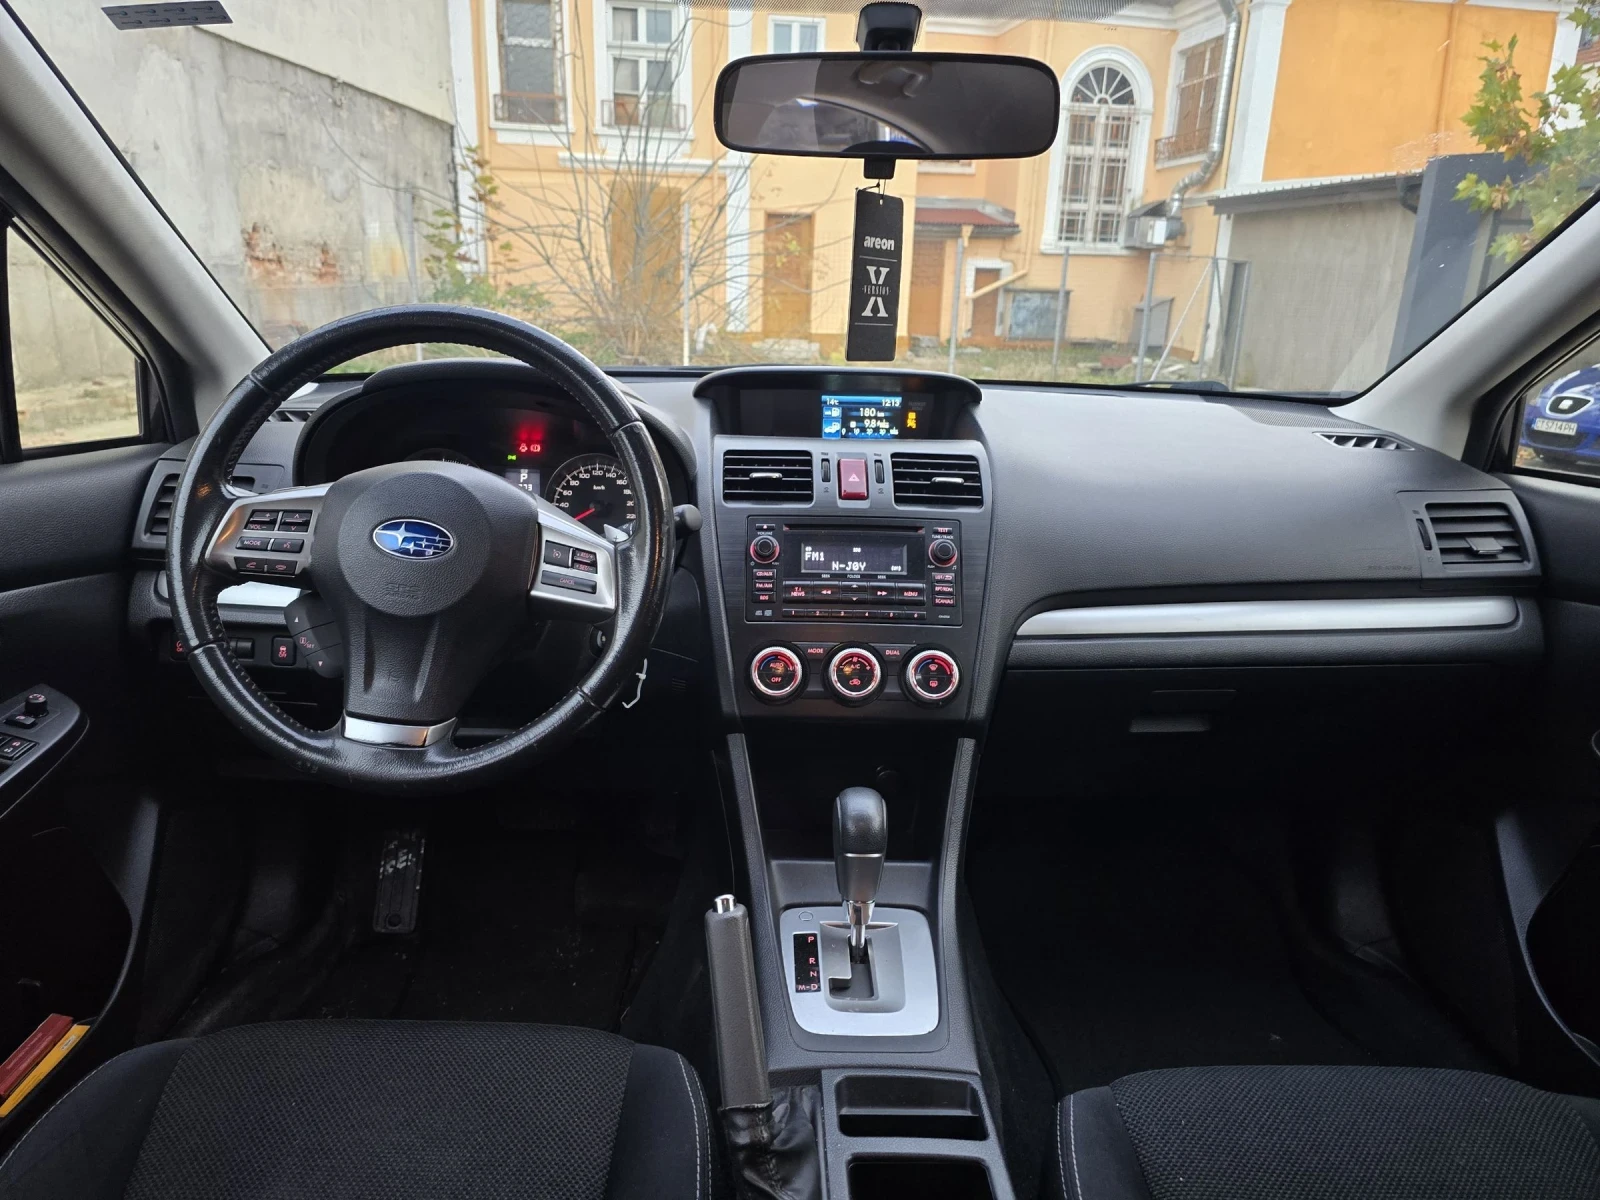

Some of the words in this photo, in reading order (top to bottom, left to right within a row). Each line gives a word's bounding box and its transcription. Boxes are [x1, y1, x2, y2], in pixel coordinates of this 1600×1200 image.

[864, 236, 894, 250] areon
[860, 408, 876, 416] 180
[520, 473, 528, 482] P
[805, 552, 824, 561] FM1
